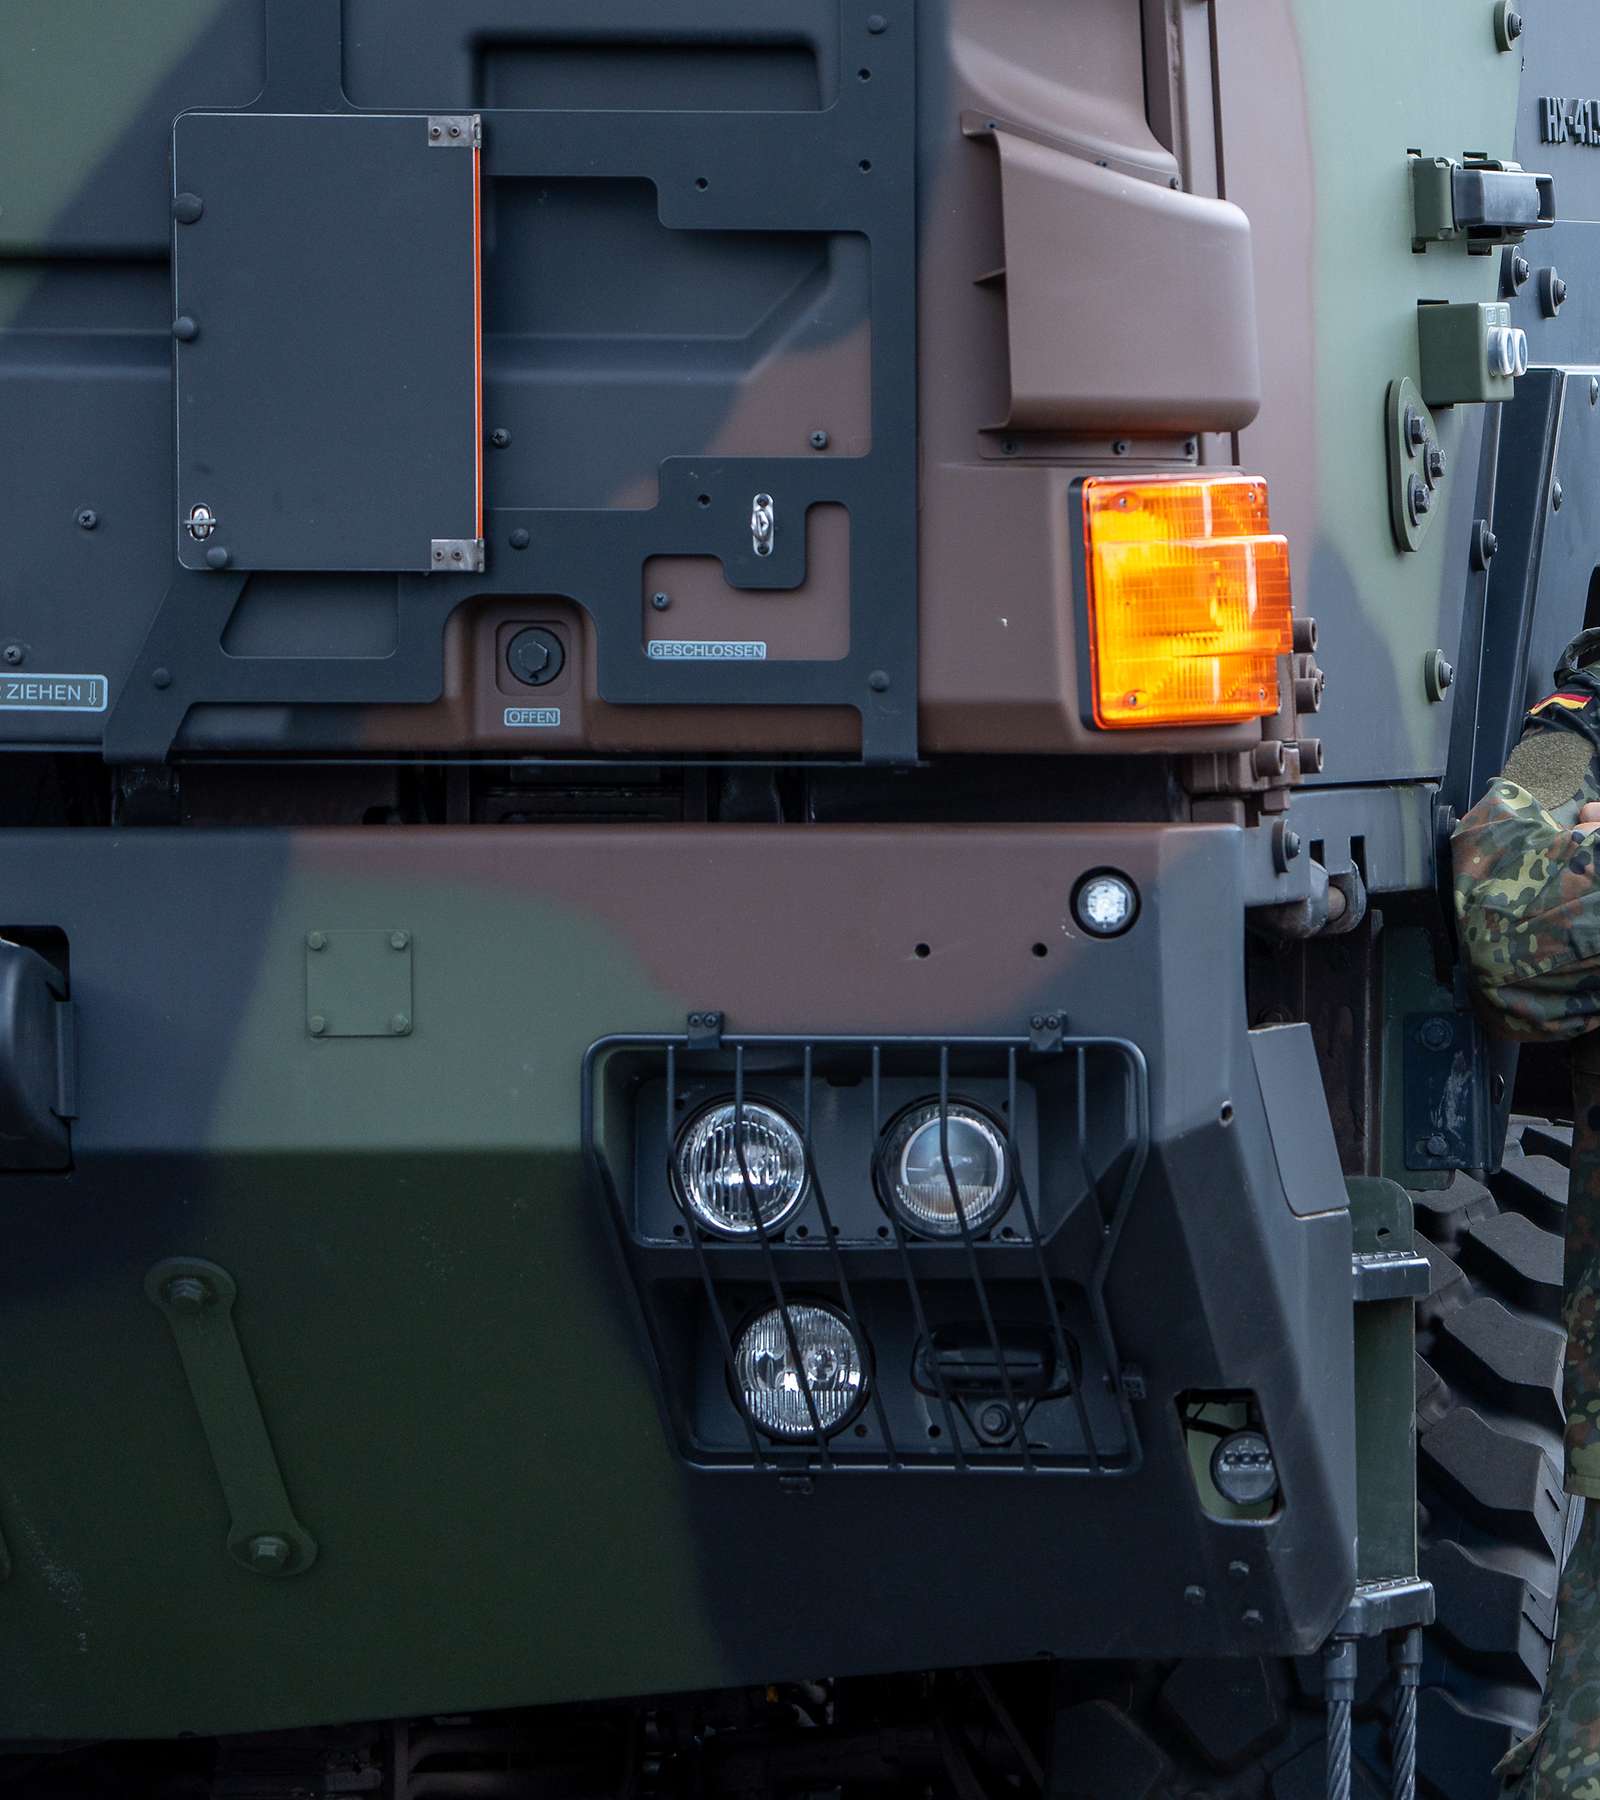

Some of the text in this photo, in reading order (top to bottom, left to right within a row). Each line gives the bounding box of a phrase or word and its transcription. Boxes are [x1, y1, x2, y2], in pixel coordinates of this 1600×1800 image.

[651, 643, 763, 657] GESCHLOSSEN
[6, 683, 81, 700] ZIEHEN
[509, 711, 556, 723] OFFEN
